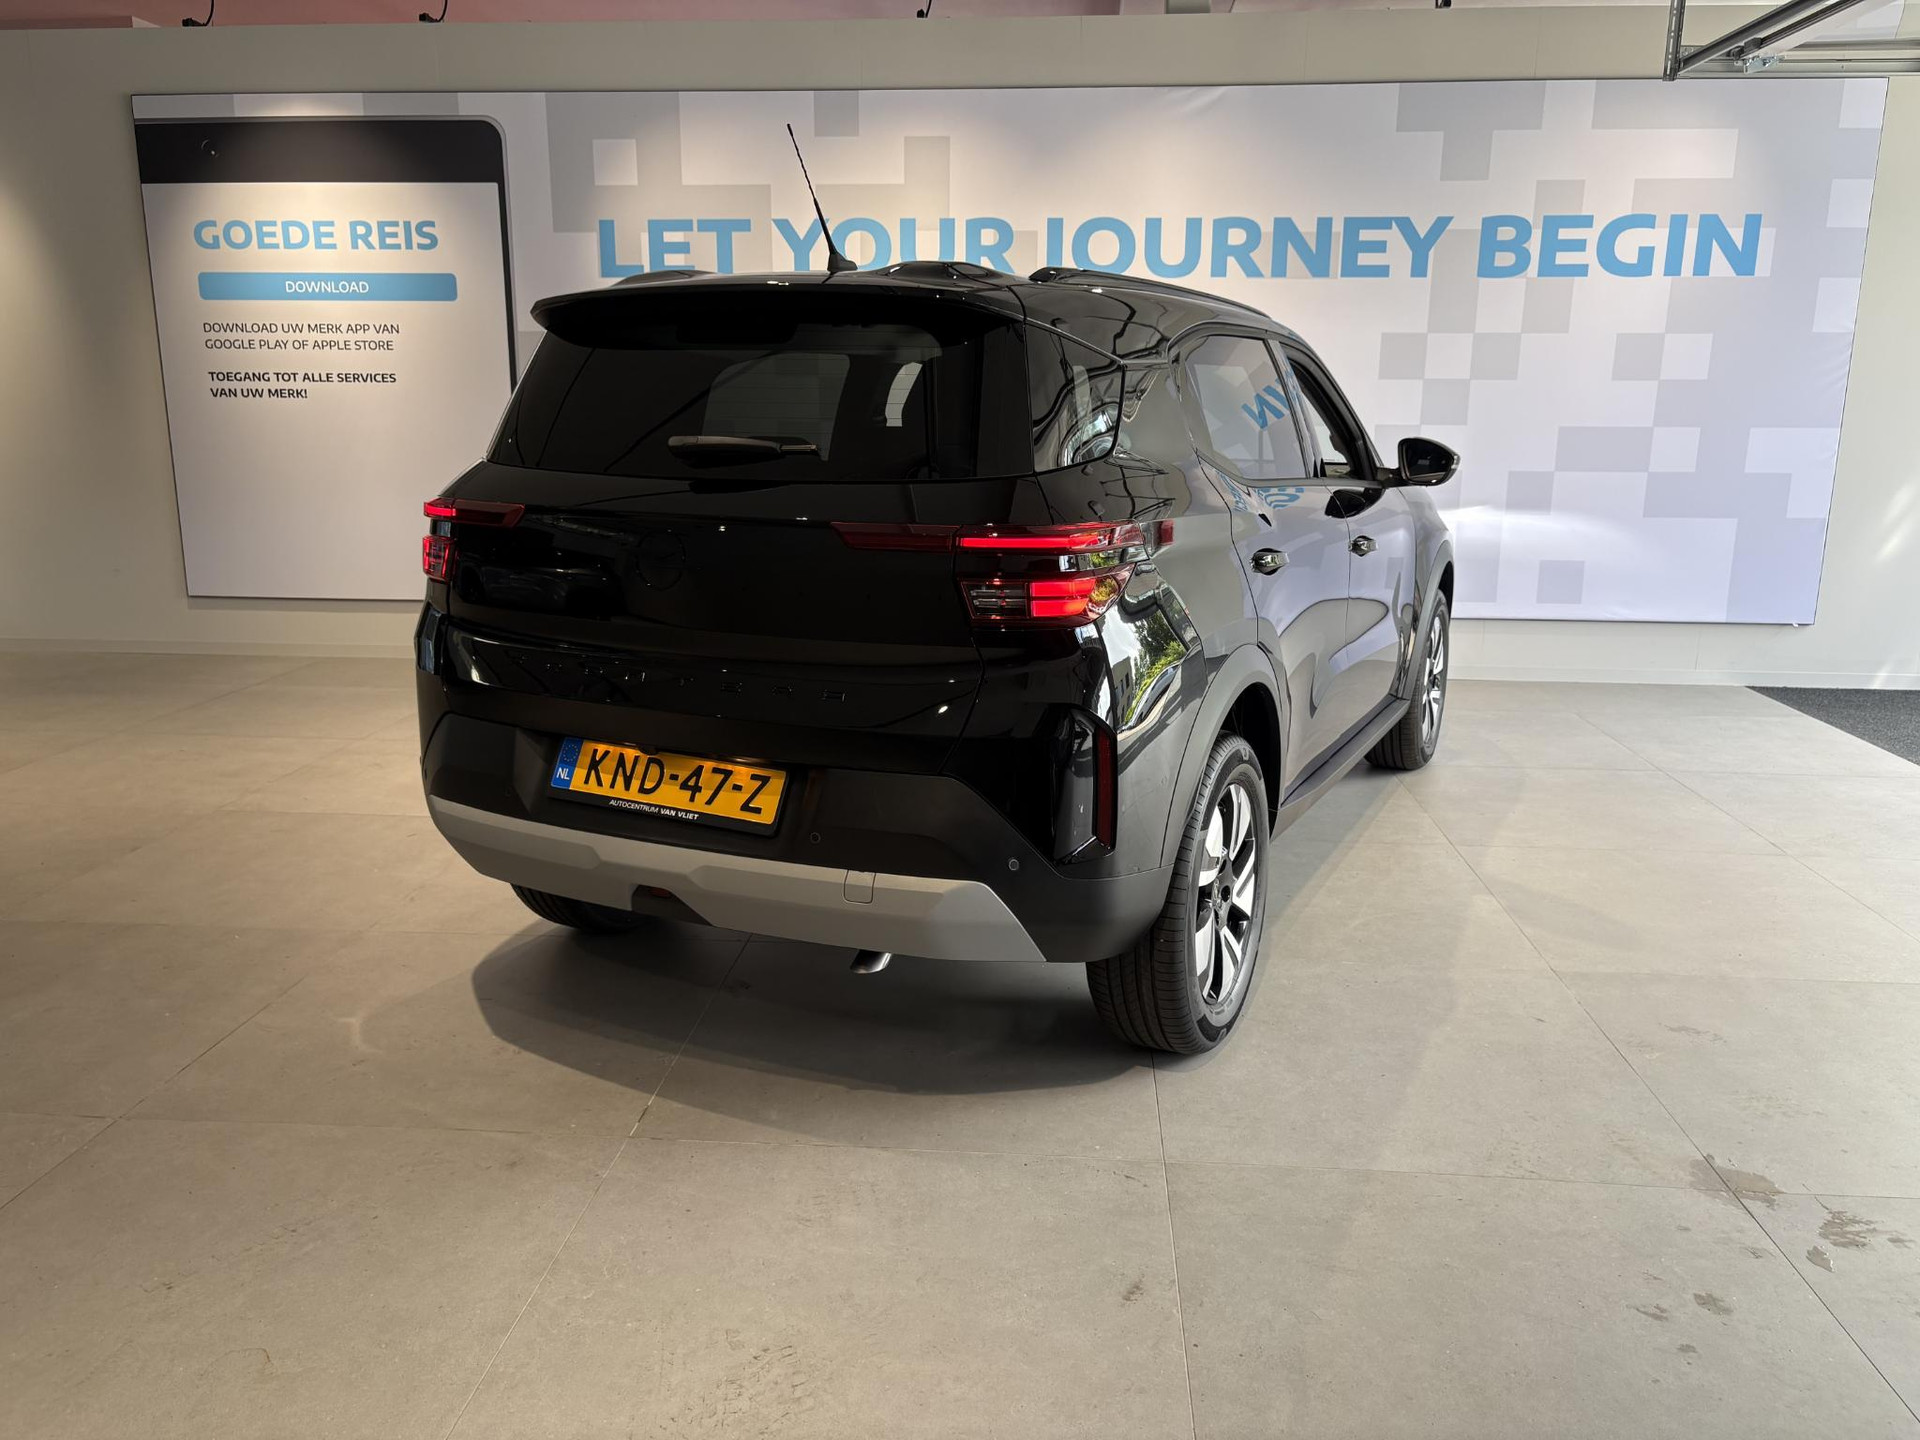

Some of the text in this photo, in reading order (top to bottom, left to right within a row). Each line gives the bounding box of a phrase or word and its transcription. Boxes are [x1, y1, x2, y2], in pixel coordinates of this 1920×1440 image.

[194, 219, 438, 251] GOEDE REIS
[599, 212, 1764, 279] LET YOUR JOURNEY BEGIN
[285, 280, 370, 294] DOWNLOAD
[202, 322, 400, 335] DOWNLOAD UW MERK APP VAN
[204, 338, 395, 351] GOOGLE PLAY OF APPLE STORE
[208, 371, 397, 384] TOEGANG TOT ALLE SERVICES
[210, 387, 308, 399] VAN UW MERK!
[555, 766, 571, 780] NL
[583, 748, 772, 815] KND-47-Z
[608, 799, 701, 821] AUTOCENTRUM VAN VLIET
